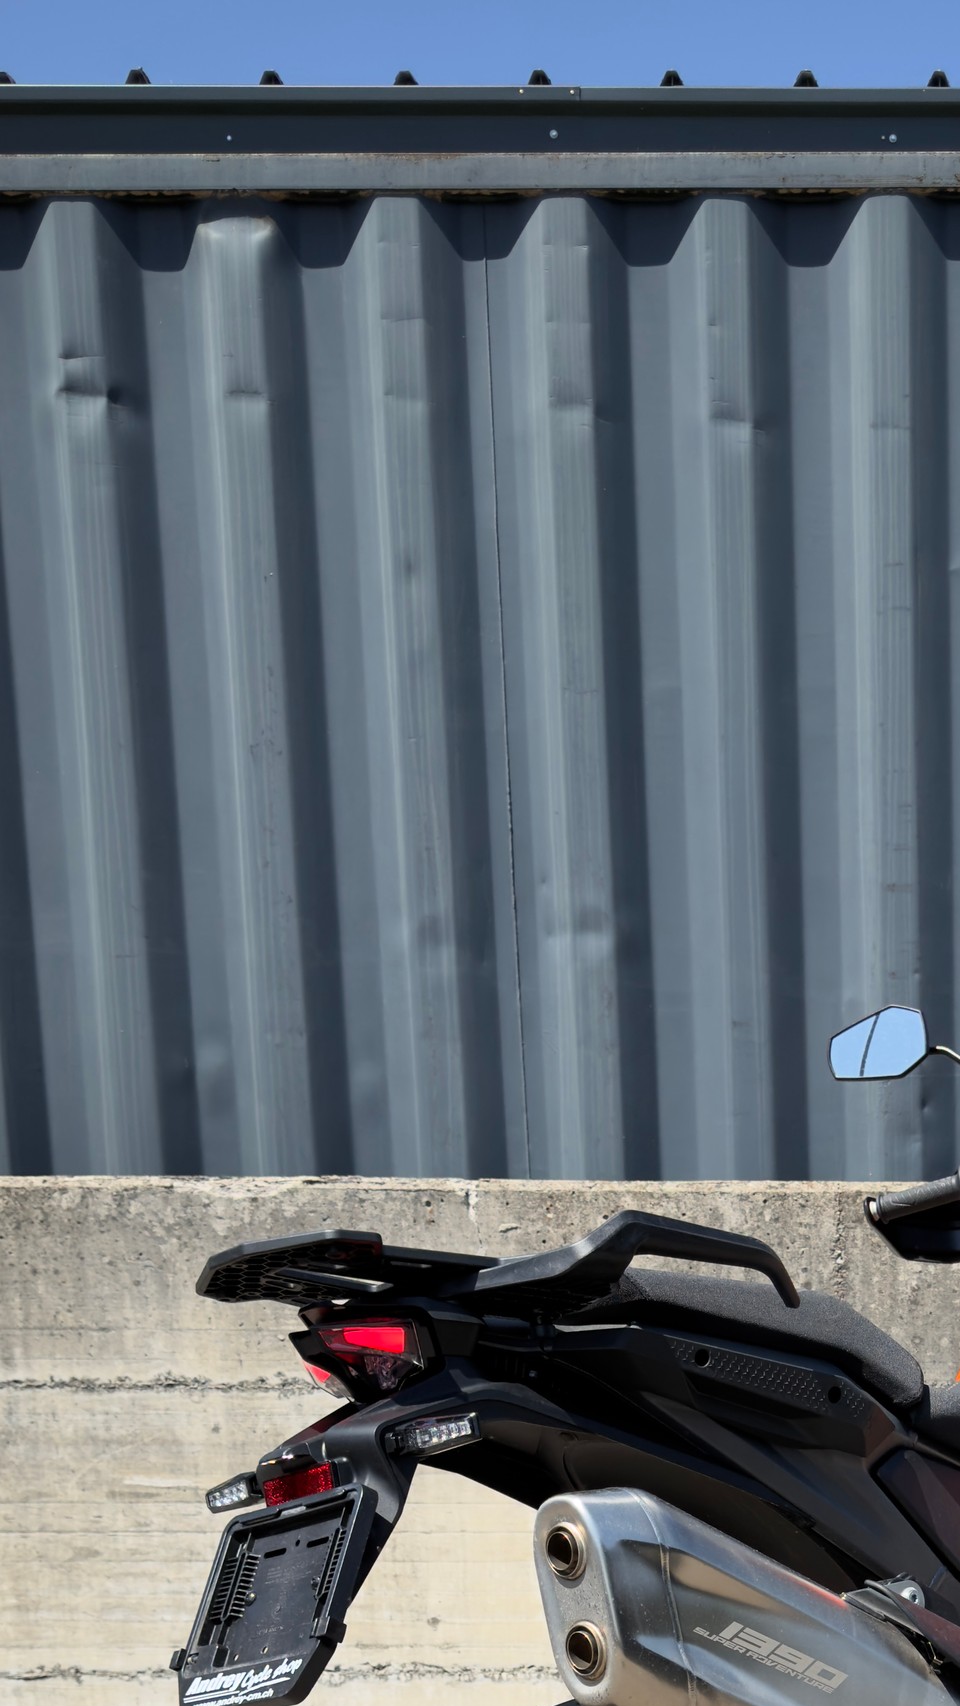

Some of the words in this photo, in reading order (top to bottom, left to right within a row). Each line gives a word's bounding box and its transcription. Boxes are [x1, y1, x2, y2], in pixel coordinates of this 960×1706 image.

[185, 1671, 246, 1695] Andrey
[693, 1626, 746, 1654] SUPER
[747, 1651, 835, 1694] ADVENTURE
[719, 1621, 848, 1689] 1390
